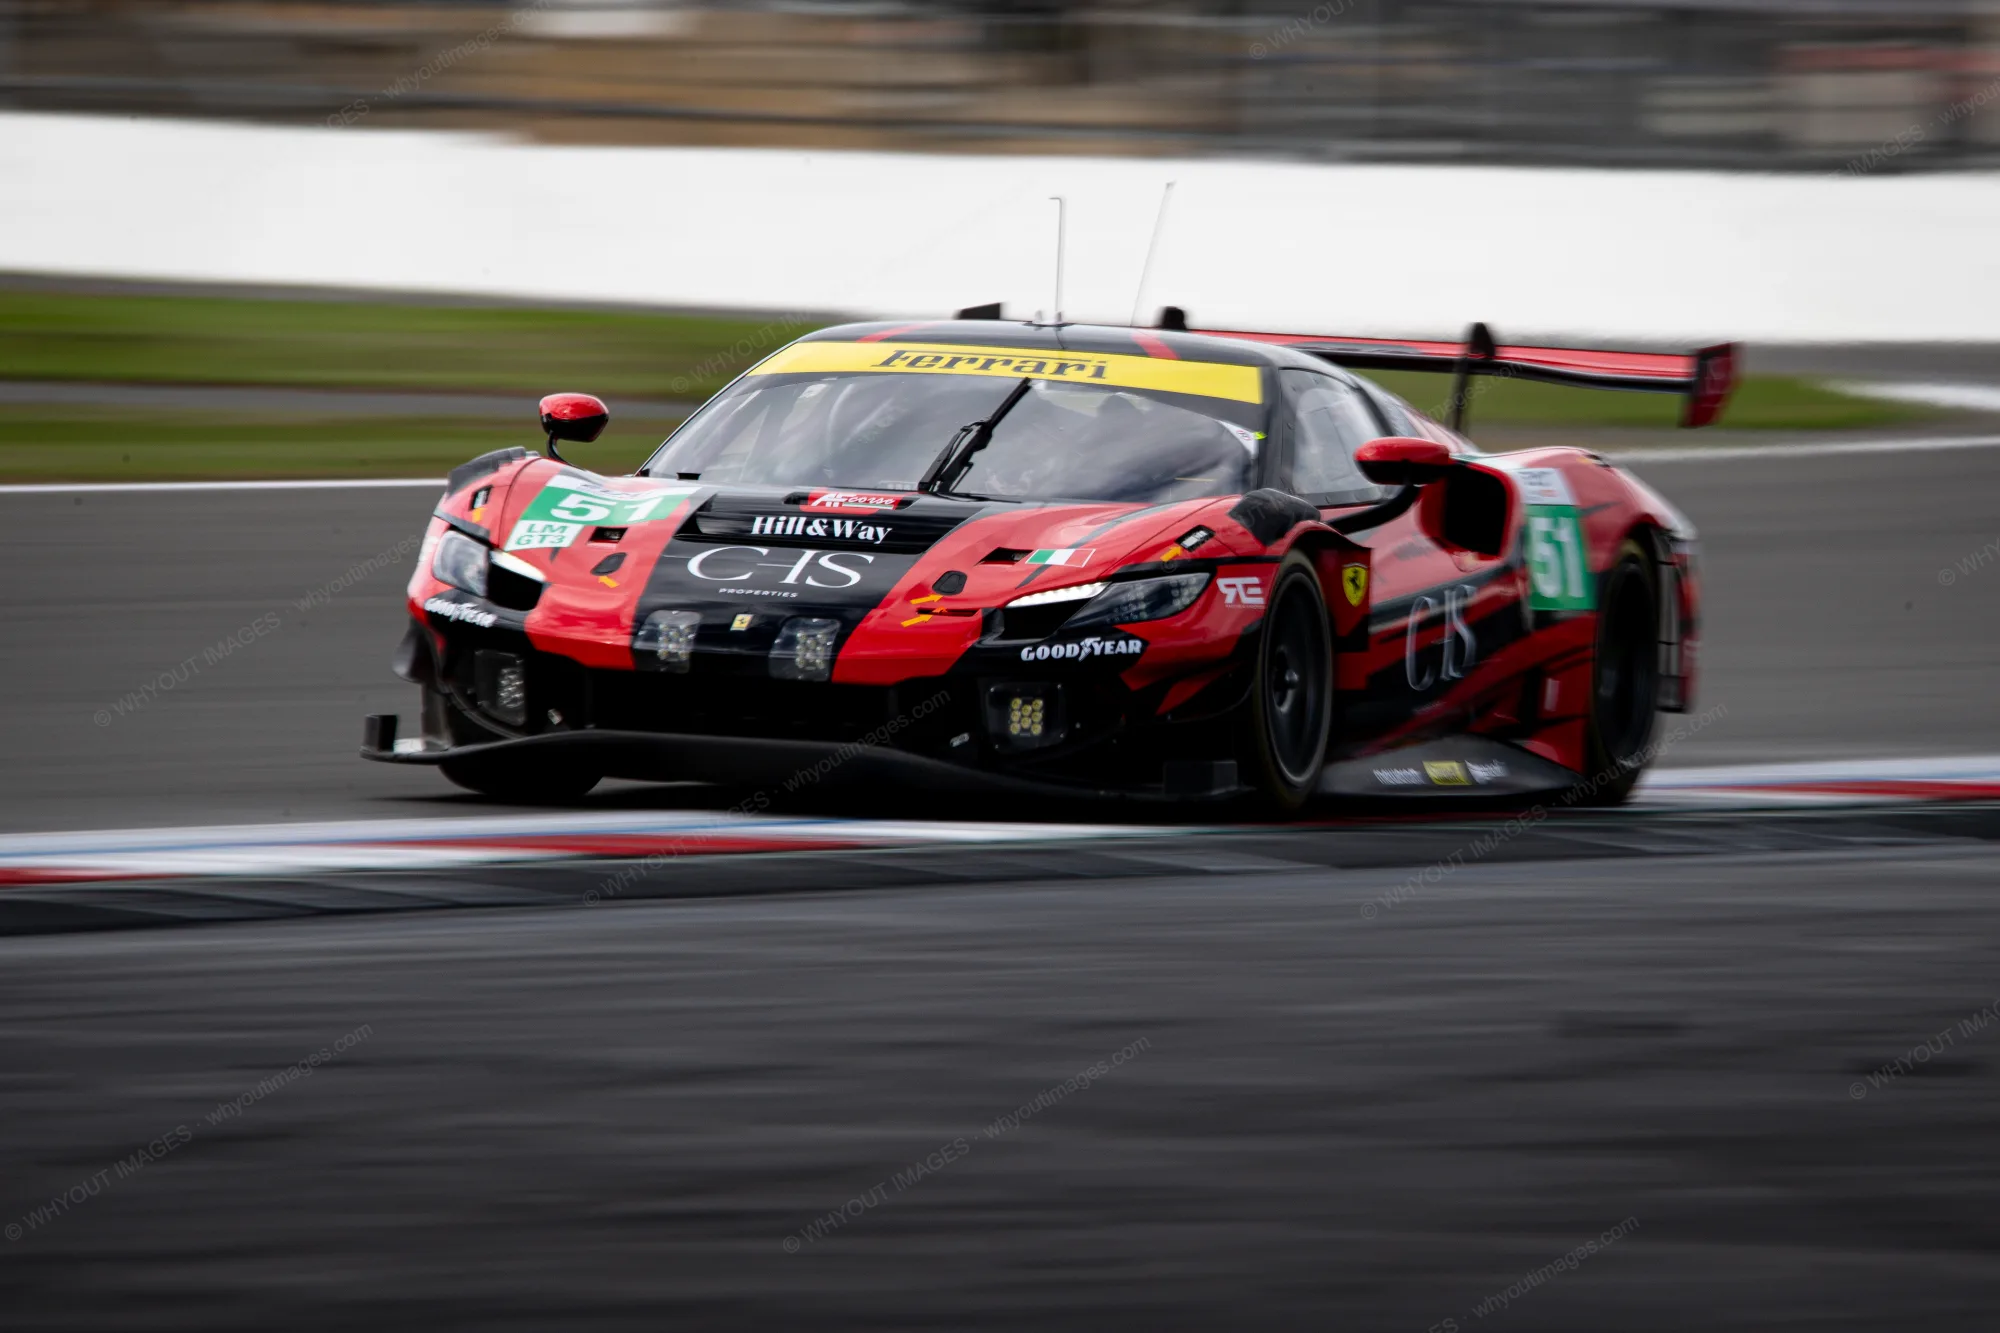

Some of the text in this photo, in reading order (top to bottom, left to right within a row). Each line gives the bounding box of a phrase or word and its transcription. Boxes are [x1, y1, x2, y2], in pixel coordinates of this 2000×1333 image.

[871, 349, 1107, 380] Ferrari
[550, 493, 665, 523] 51
[515, 534, 565, 546] GT3
[526, 523, 568, 534] LM
[751, 515, 893, 544] Hill&Way
[1528, 516, 1586, 598] 51
[718, 587, 799, 598] PROPERTIES
[1020, 637, 1142, 661] GOODYEAR
